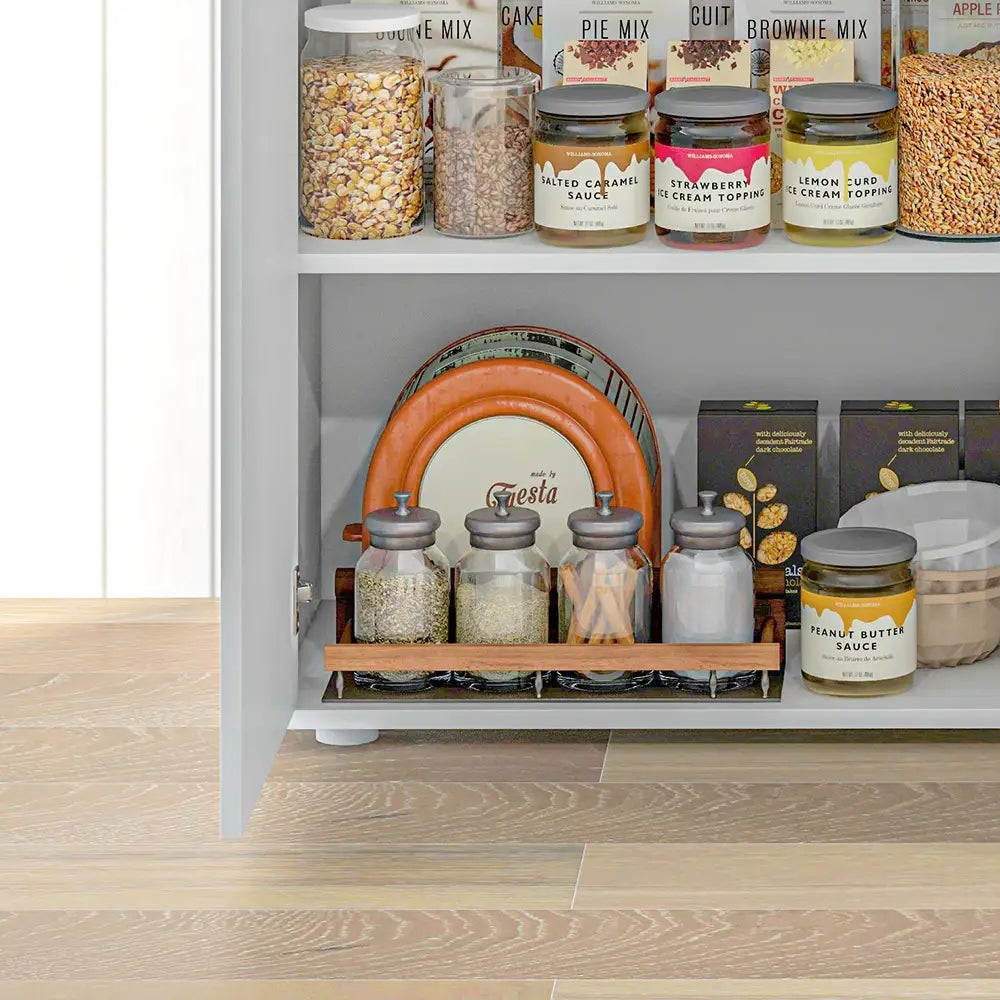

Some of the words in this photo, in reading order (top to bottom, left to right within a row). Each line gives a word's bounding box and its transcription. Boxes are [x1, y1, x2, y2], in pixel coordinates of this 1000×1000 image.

[953, 2, 992, 15] APPLE
[501, 5, 543, 26] CAKE
[441, 19, 472, 40] MIX
[582, 19, 608, 39] PIE
[619, 19, 650, 39] MIX
[747, 19, 827, 40] BROWNIE
[837, 19, 868, 39] MIX
[541, 176, 579, 188] SALTED
[585, 176, 638, 188] CARAMEL
[671, 180, 748, 190] STRAWBERRY
[799, 176, 839, 187] LEMON
[847, 176, 878, 187] CURD
[568, 191, 609, 200] SAUCE
[657, 189, 669, 199] ICE
[672, 192, 712, 202] CREAM
[718, 189, 765, 202] TOPPING
[800, 188, 840, 199] CREAM
[847, 185, 892, 199] TOPPING
[549, 470, 556, 478] by
[810, 626, 855, 639] PEANUT
[860, 627, 904, 639] BUTTER
[836, 642, 877, 651] SAUCE
